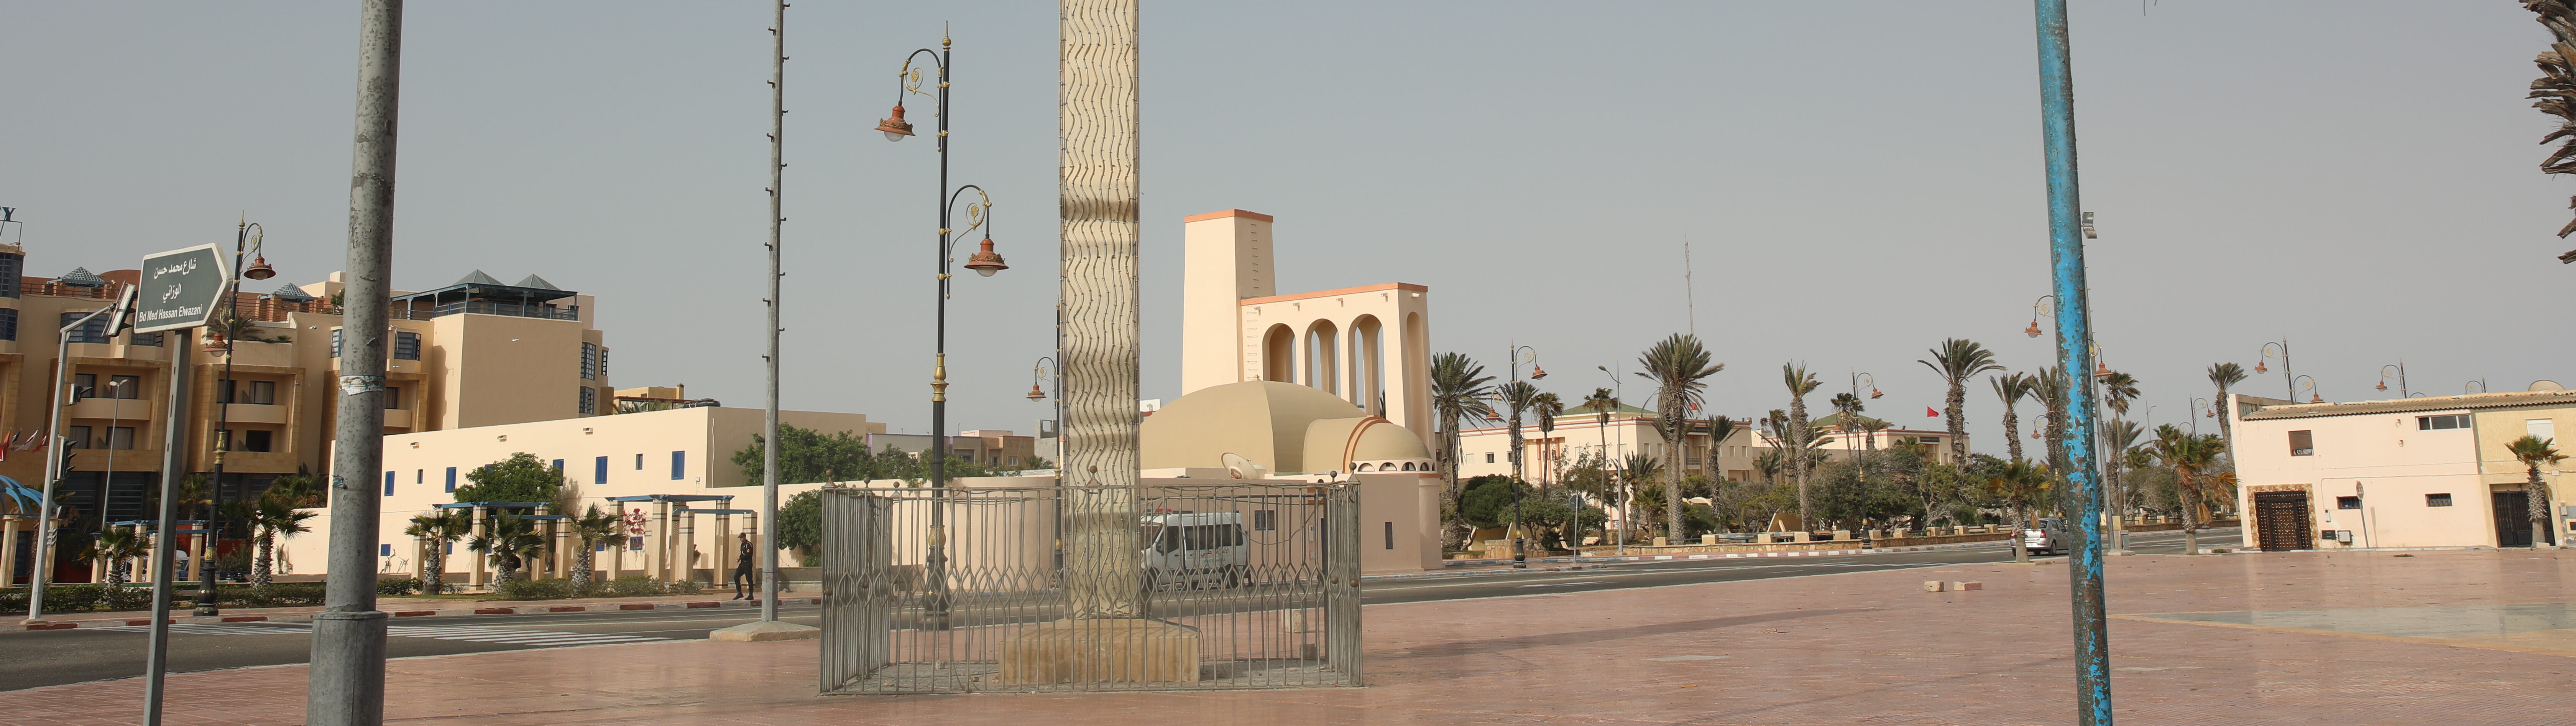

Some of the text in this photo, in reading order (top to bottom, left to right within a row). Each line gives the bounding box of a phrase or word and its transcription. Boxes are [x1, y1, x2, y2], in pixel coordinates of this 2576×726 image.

[0, 206, 16, 221] Y
[154, 258, 196, 279] شارع محمد حسن
[163, 283, 181, 303] الوزاني
[139, 304, 202, 322] Bd Med Hassan Elwazani
